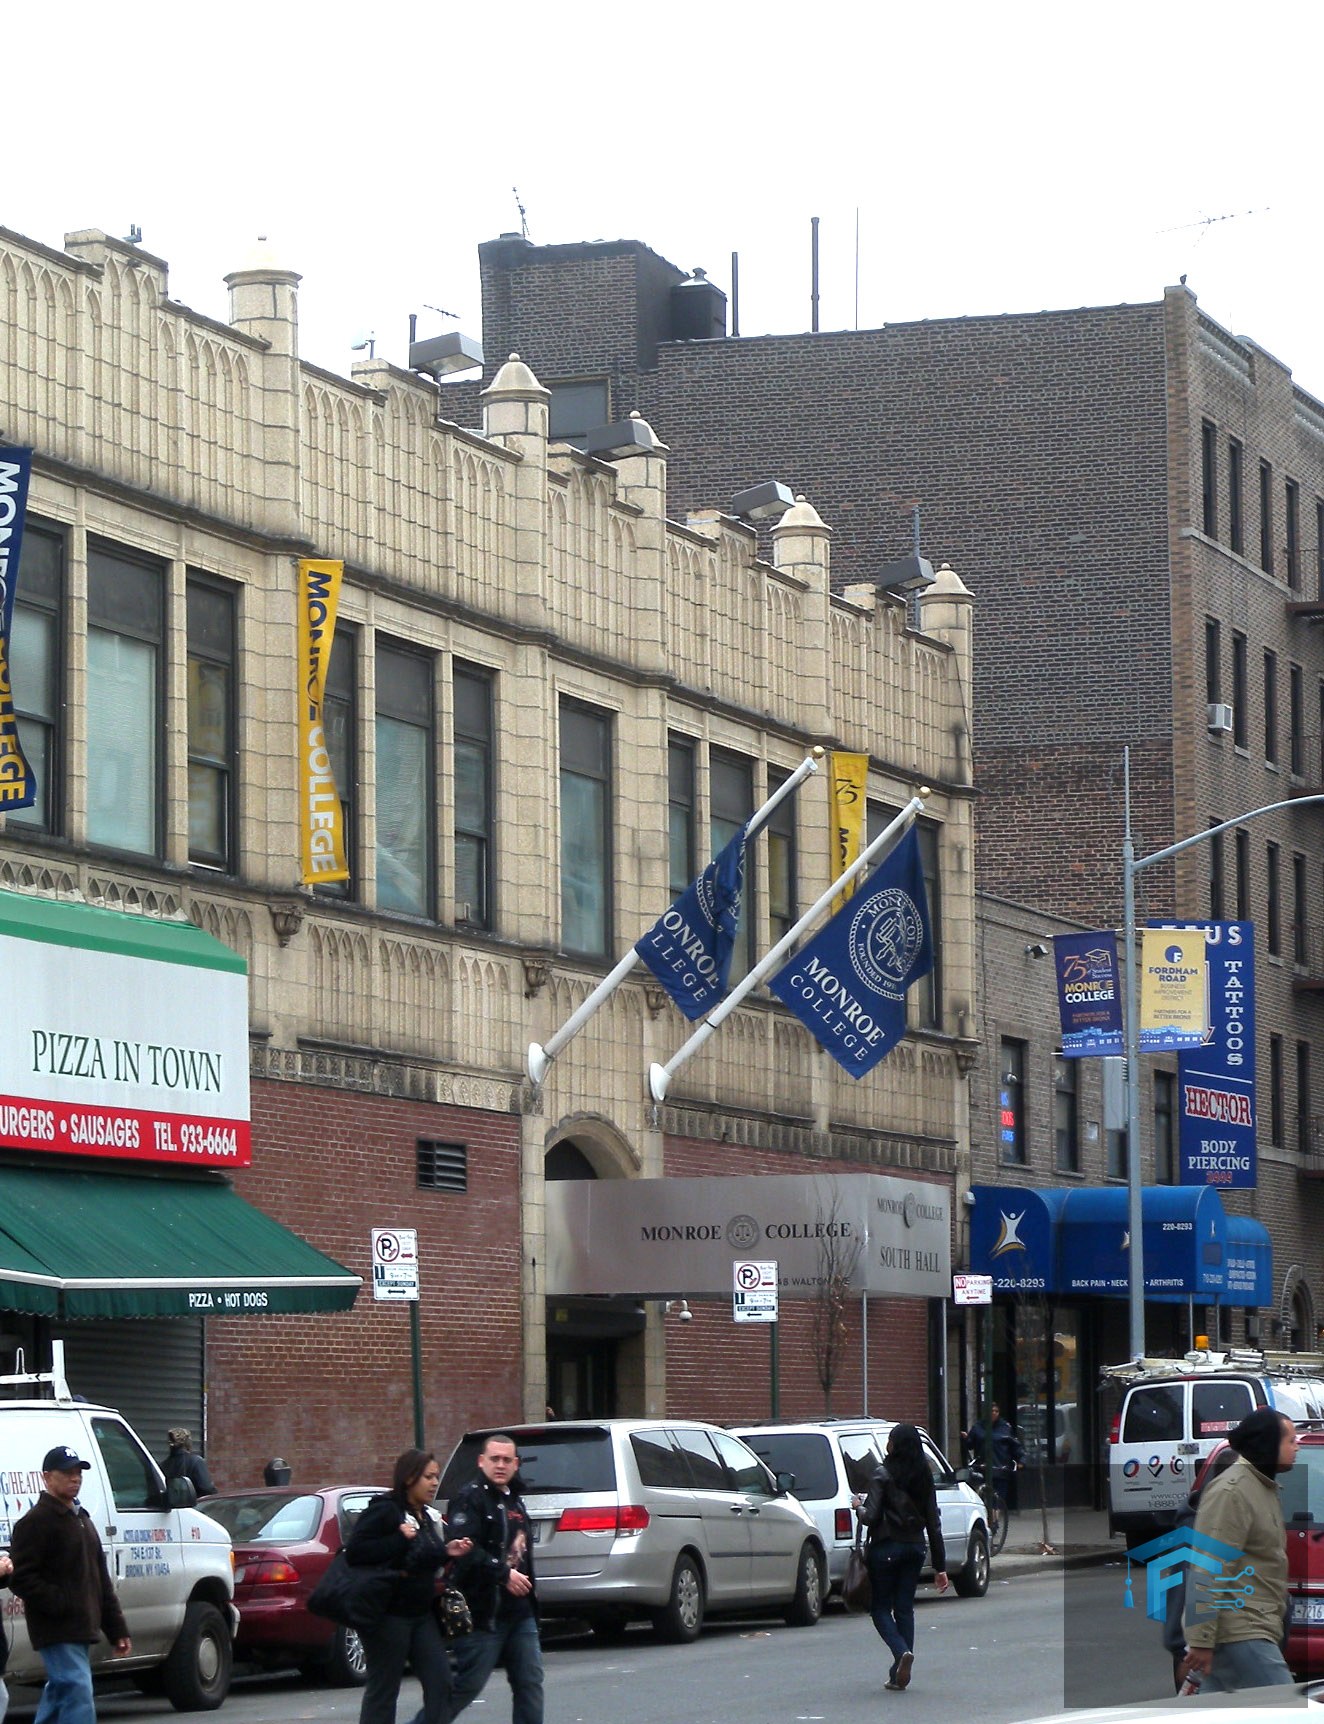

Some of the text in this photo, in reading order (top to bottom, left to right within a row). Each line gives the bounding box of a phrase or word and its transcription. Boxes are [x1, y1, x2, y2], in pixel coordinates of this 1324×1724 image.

[308, 726, 337, 873] COLLEGE
[661, 904, 720, 990] ONROE
[1064, 956, 1090, 983] 75
[1148, 967, 1198, 975] FORDHAM
[1158, 974, 1187, 983] ROAD
[1064, 979, 1115, 994] MONROE
[803, 956, 886, 1047] MONROE
[1065, 989, 1115, 1004] COLLEGE
[790, 974, 869, 1061] COLLEGE
[1224, 960, 1244, 1066] TATTOOS
[32, 1030, 222, 1093] PIZZA IN TOWN
[1184, 1085, 1253, 1127] HECTOR
[70, 1113, 140, 1149] SAUSAGES
[153, 1121, 178, 1152] TEL.
[180, 1123, 238, 1157] 933-6664
[1200, 1140, 1238, 1154] BODY
[1187, 1156, 1251, 1171] PIERCING
[916, 1203, 944, 1222] COLLEGE
[640, 1222, 851, 1241] MONROE COLLEGE
[1162, 1222, 1193, 1231] 220-8293
[880, 1245, 941, 1273] SOUTH HALL
[792, 1277, 829, 1286] WALTON
[955, 1277, 966, 1288] NO
[1071, 1279, 1185, 1287] BACK PAIN NECK ARTHRITIS
[188, 1291, 268, 1307] PIZZA HOT DOGS
